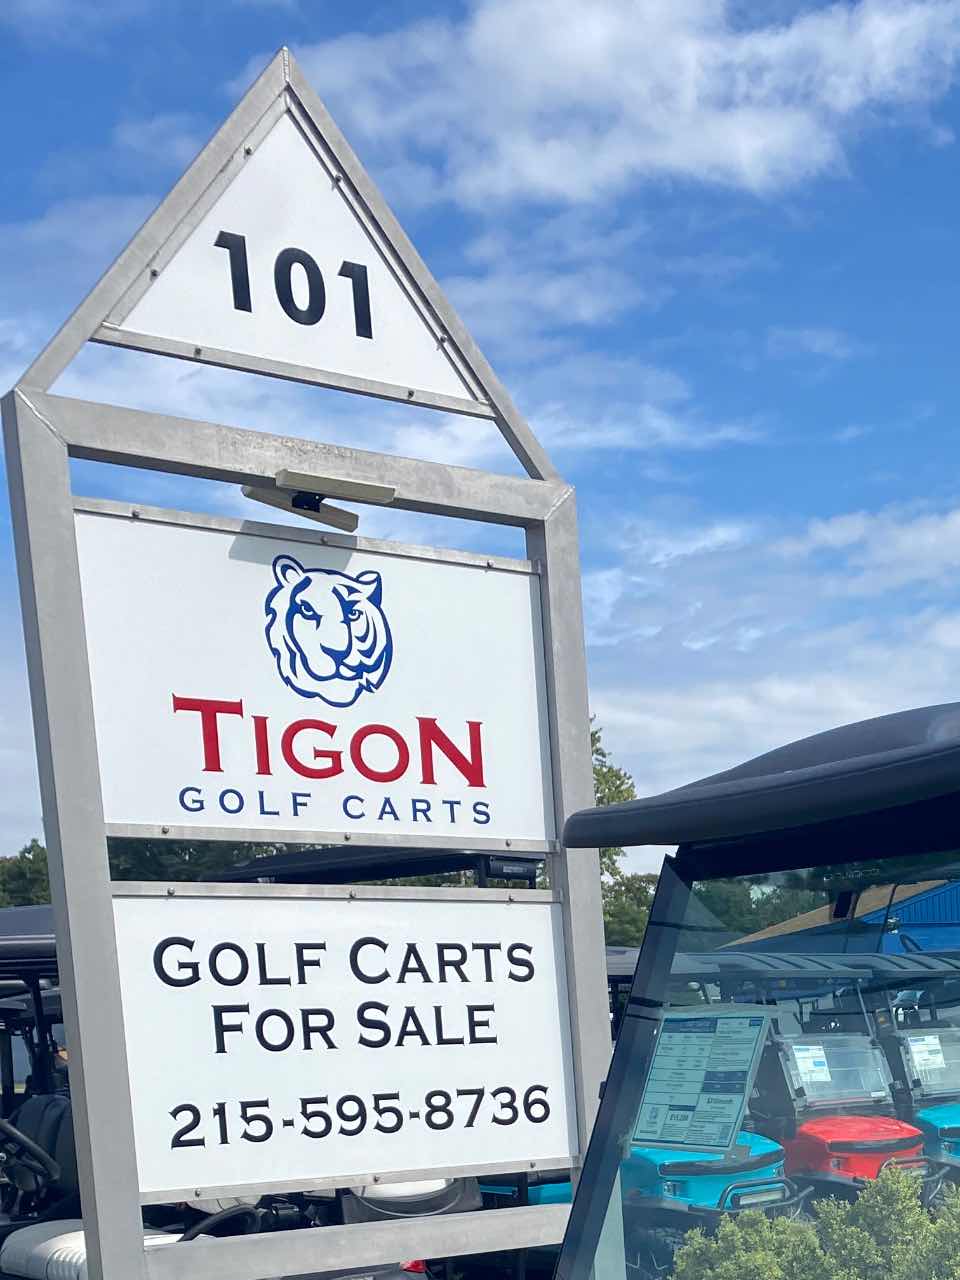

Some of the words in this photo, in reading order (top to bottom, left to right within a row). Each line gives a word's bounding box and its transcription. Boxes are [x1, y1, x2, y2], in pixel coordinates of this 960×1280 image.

[213, 230, 374, 340] 101
[171, 690, 488, 789] TIGON
[178, 786, 313, 818] GOLF
[342, 794, 492, 825] CARTS
[152, 935, 328, 989] GOLF
[348, 935, 536, 986] CARTS
[211, 1002, 337, 1054] FOR
[356, 1000, 499, 1049] SALE
[168, 1083, 552, 1151] 215-595-8736
